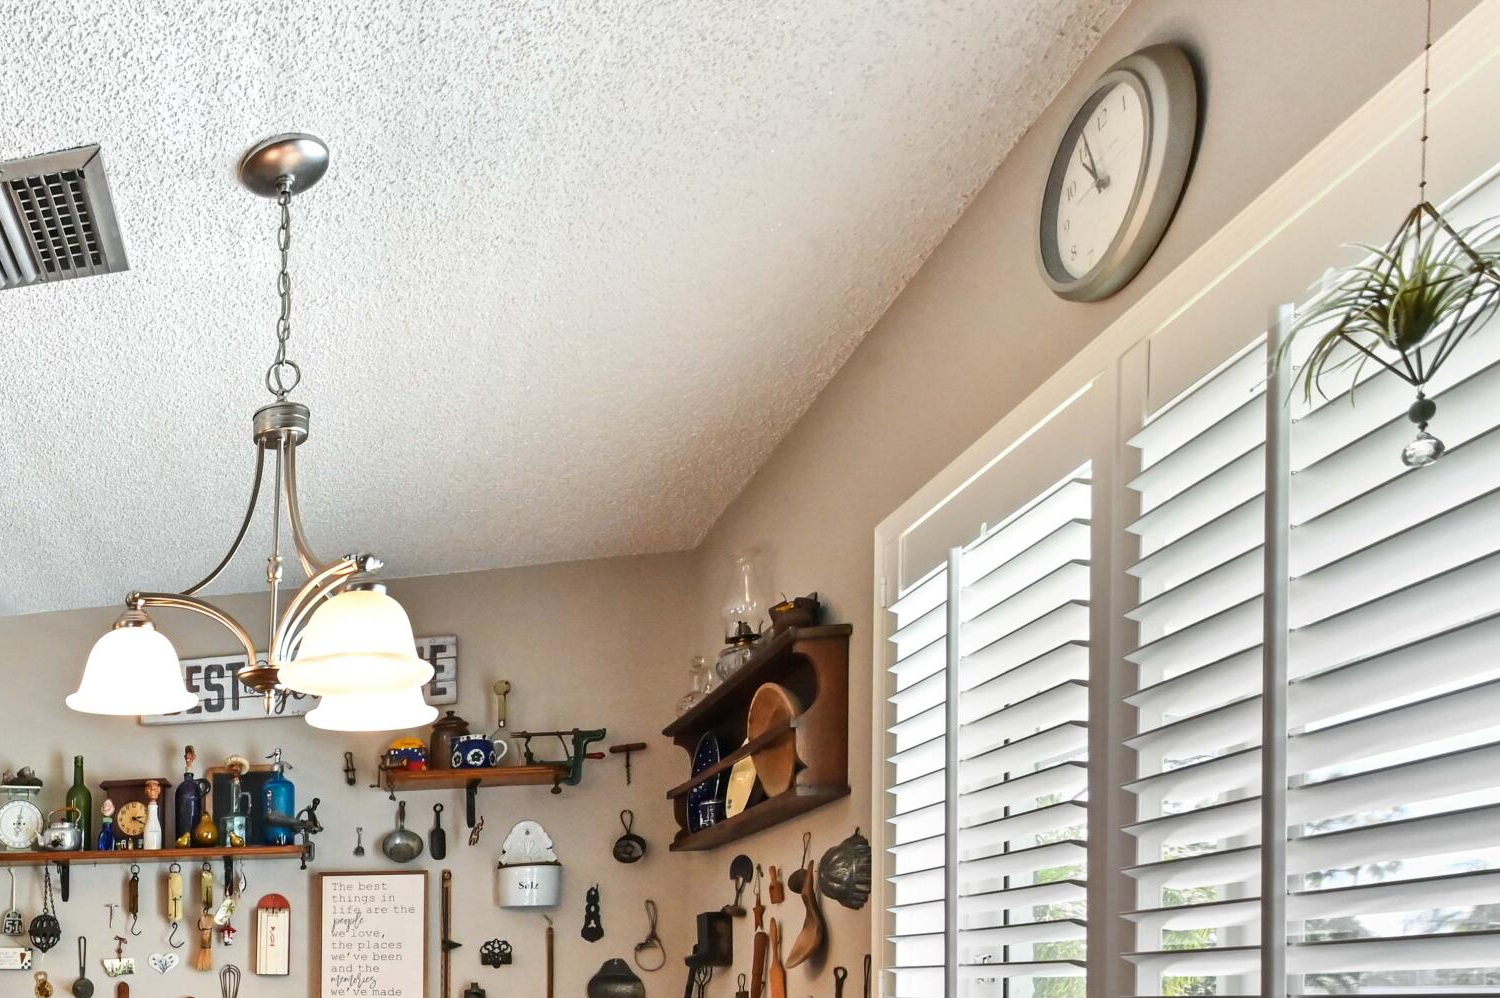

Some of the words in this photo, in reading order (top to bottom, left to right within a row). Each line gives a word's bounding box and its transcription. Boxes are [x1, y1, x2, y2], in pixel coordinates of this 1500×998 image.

[1096, 107, 1108, 132] 12
[1065, 179, 1077, 202] 10
[1063, 219, 1070, 236] 9
[164, 661, 246, 715] EST
[332, 882, 354, 891] The
[358, 882, 388, 891] best
[332, 894, 376, 904] things
[381, 894, 395, 902] in
[332, 905, 361, 915] life
[366, 906, 388, 914] are
[393, 905, 415, 914] the
[331, 911, 364, 933] people
[331, 930, 346, 938] we
[351, 929, 385, 939] love,
[331, 940, 353, 949] the
[358, 940, 403, 952] places
[331, 952, 368, 961] we've
[372, 952, 403, 961] been
[331, 964, 353, 973] and
[358, 964, 380, 973] the
[330, 973, 377, 989] memories
[330, 987, 368, 996] we've
[372, 988, 403, 996] made
